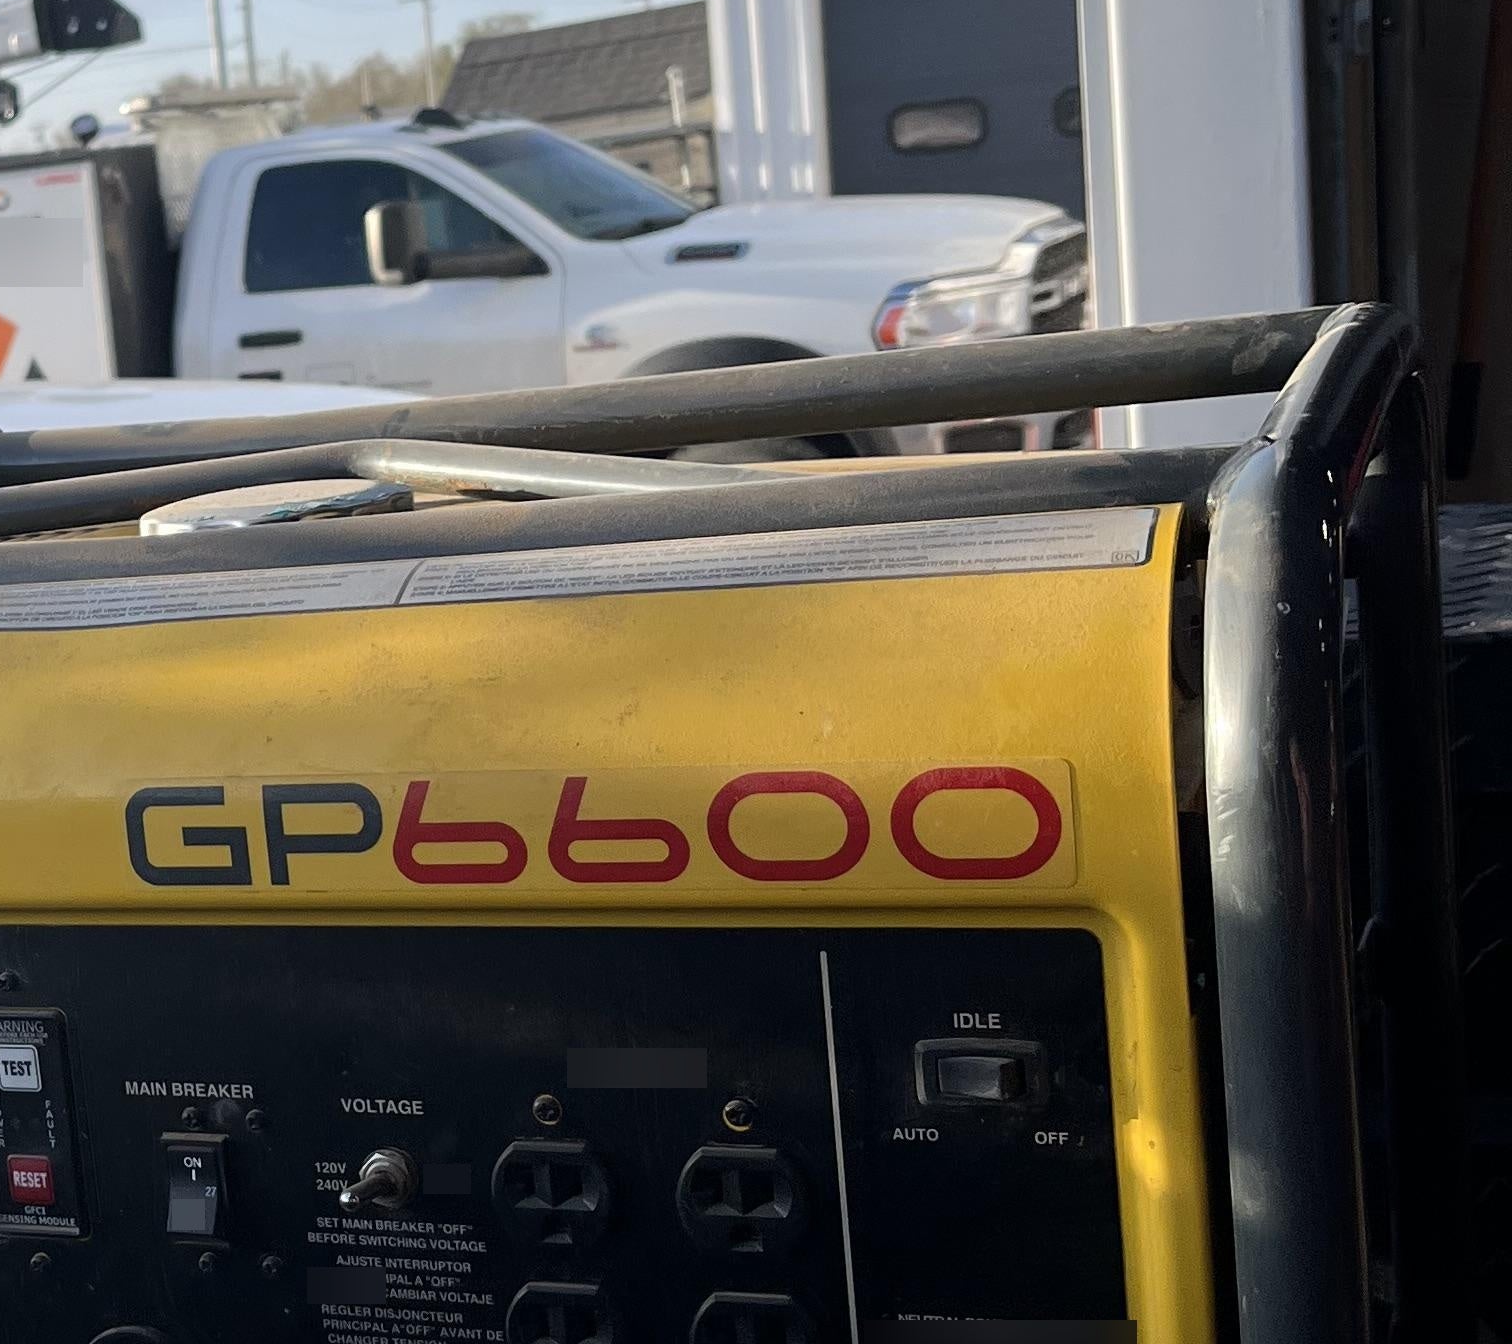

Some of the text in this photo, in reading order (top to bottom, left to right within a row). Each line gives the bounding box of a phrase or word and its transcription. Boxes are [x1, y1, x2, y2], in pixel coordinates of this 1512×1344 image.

[125, 765, 1061, 886] GP6600
[953, 1012, 1002, 1030] IDLE
[1, 1060, 32, 1076] TEST
[125, 1081, 254, 1099] MAIN BREAKER
[340, 1098, 424, 1115] VOLTAGE
[45, 1100, 56, 1148] FAULT
[892, 1127, 939, 1142] AUTO
[1034, 1131, 1069, 1145] OFF
[183, 1156, 202, 1169] ON
[314, 1162, 347, 1174] 120V
[13, 1170, 48, 1188] RESET
[315, 1179, 348, 1191] 240V
[24, 1205, 46, 1215] GFCI
[39, 1216, 76, 1227] MODULE
[316, 1217, 473, 1235] SET MAIN BREAKER "OFF"
[307, 1232, 487, 1253] BEFORE SWITCHING VOLTAGE
[335, 1255, 472, 1273] AJUSTE INTERRUPTOR
[415, 1275, 424, 1287] A
[425, 1276, 461, 1288] "OFF"
[439, 1291, 495, 1305] VOLTAJE
[321, 1304, 463, 1324] REGLER DISJONCTEUR
[323, 1318, 388, 1333] PRINCIPAL
[440, 1327, 482, 1340] AVANT
[486, 1330, 505, 1342] DE
